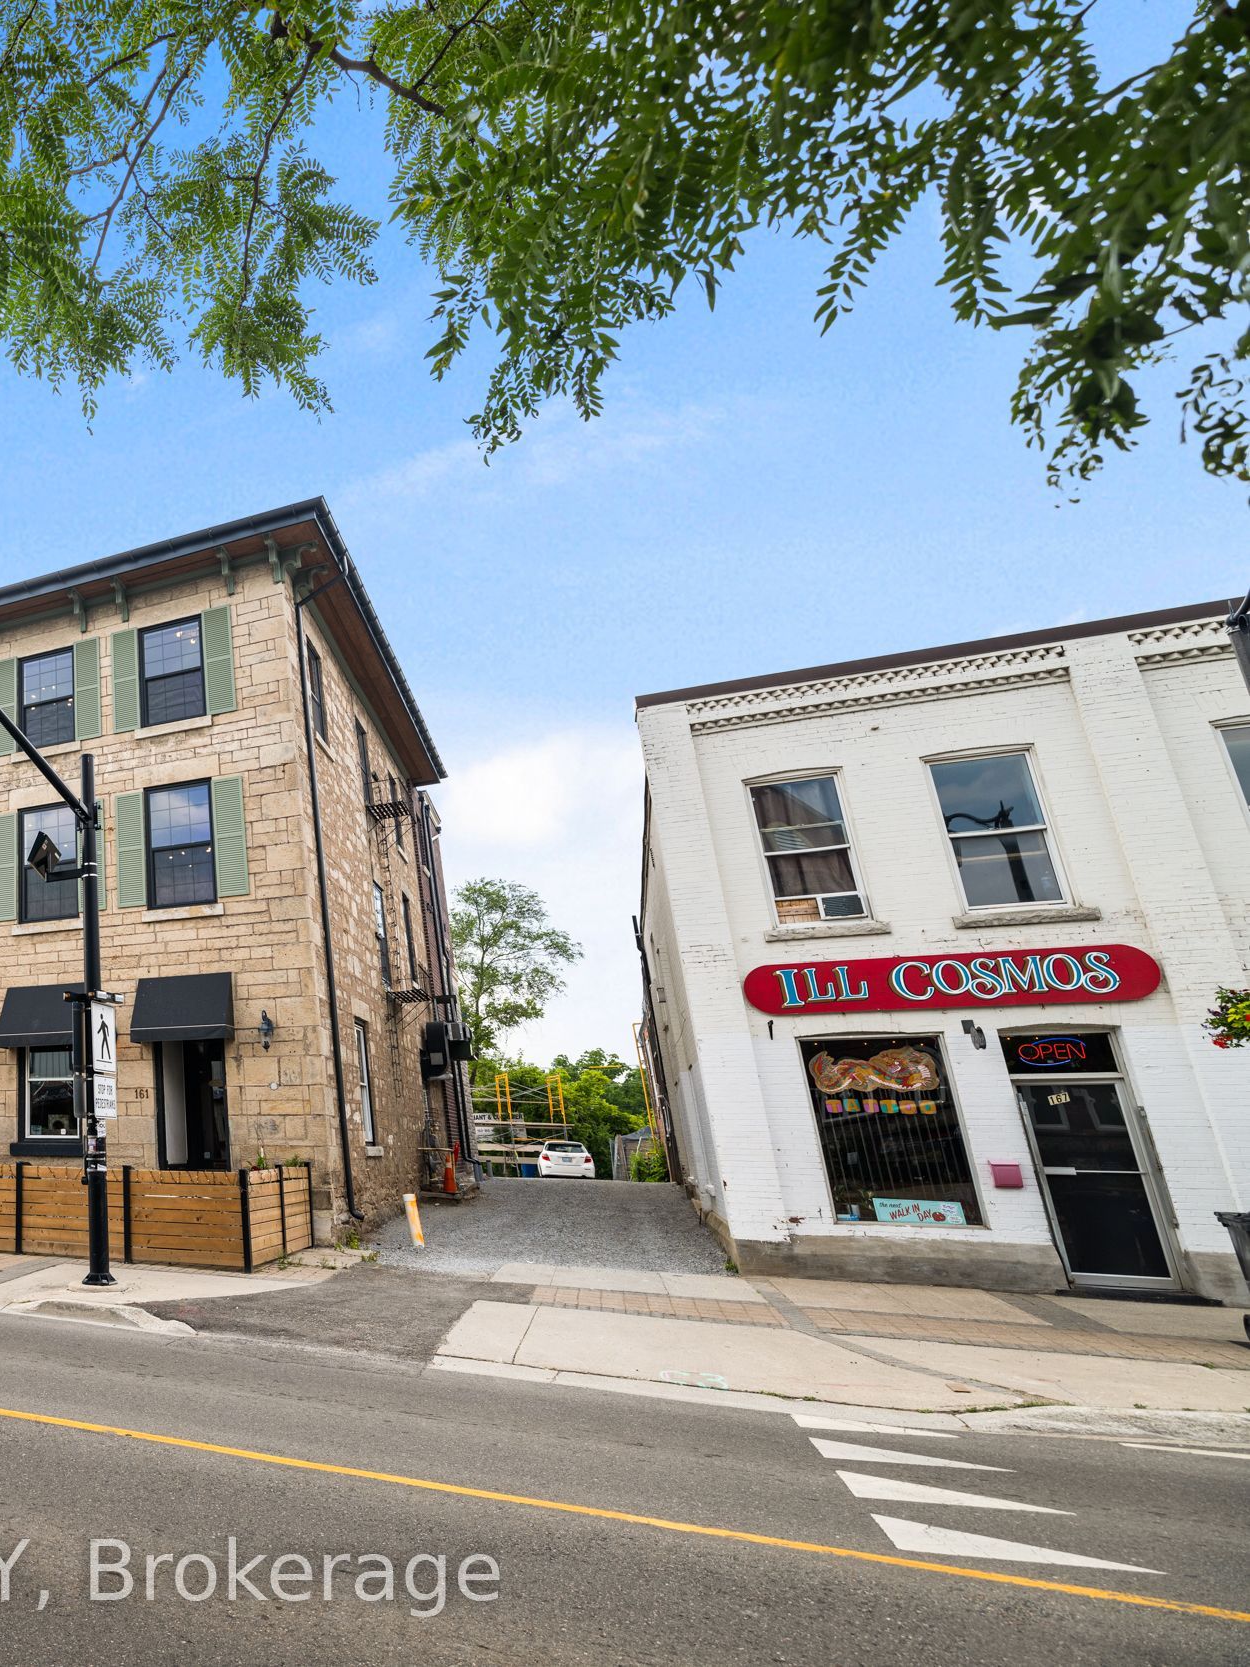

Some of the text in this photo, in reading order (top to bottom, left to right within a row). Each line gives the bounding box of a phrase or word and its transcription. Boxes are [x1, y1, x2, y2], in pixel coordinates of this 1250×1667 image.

[773, 950, 1123, 1009] ILL COSMOS
[1017, 1041, 1087, 1060] OPEN
[134, 1088, 149, 1099] 161
[1049, 1093, 1069, 1105] 167
[825, 1097, 937, 1115] TATTOO
[889, 1203, 921, 1221] WALK IN
[917, 1209, 932, 1221] DAY
